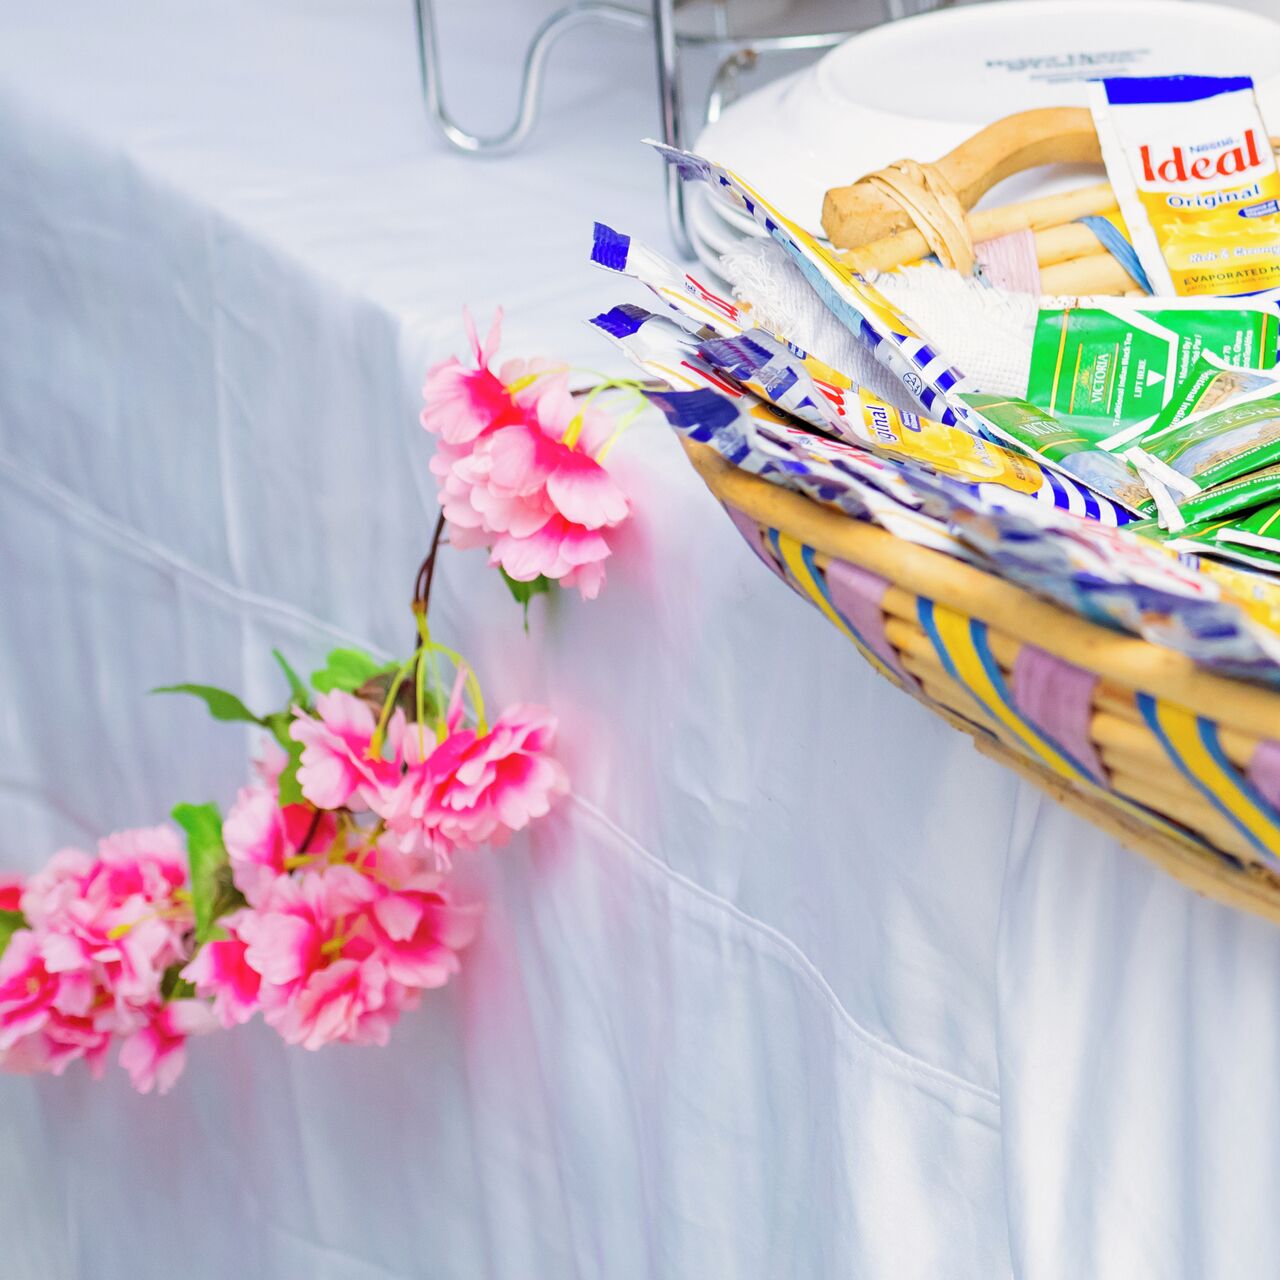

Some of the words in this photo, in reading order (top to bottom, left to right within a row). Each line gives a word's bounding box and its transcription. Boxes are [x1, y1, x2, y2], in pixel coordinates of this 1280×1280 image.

[1139, 129, 1261, 183] Ideal
[1168, 184, 1260, 208] Original
[1184, 267, 1268, 286] EVAPORATED
[1122, 345, 1131, 365] Black
[1223, 345, 1231, 354] 70
[1092, 353, 1109, 403] VICTORIA
[1119, 366, 1127, 388] Indian
[1137, 359, 1147, 378] HERE
[1134, 378, 1143, 398] LIFT
[1202, 446, 1261, 476] Traditional
[1190, 481, 1252, 505] Traditional
